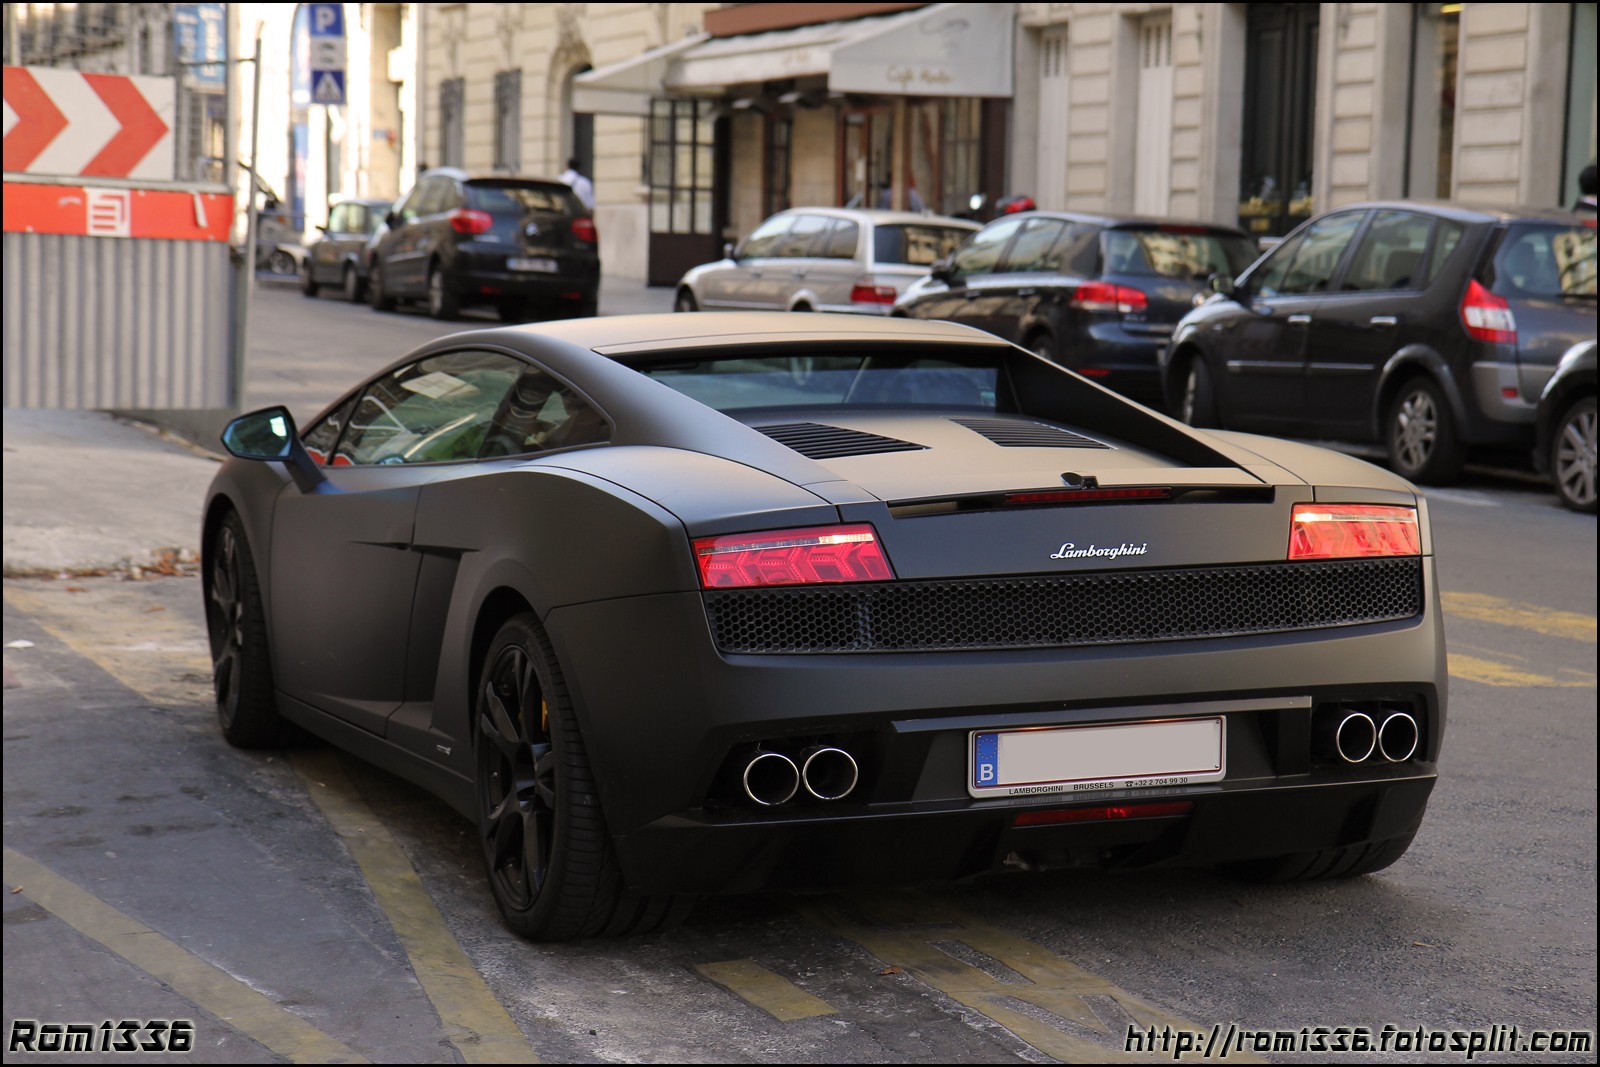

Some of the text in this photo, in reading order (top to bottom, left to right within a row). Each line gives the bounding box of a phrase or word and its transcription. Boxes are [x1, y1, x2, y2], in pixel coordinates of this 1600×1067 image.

[315, 6, 336, 32] P
[1050, 542, 1148, 560] Lamborghini
[980, 763, 994, 781] B
[1008, 785, 1063, 795] LAMBORGHINI
[1073, 782, 1114, 791] BRUSSELS
